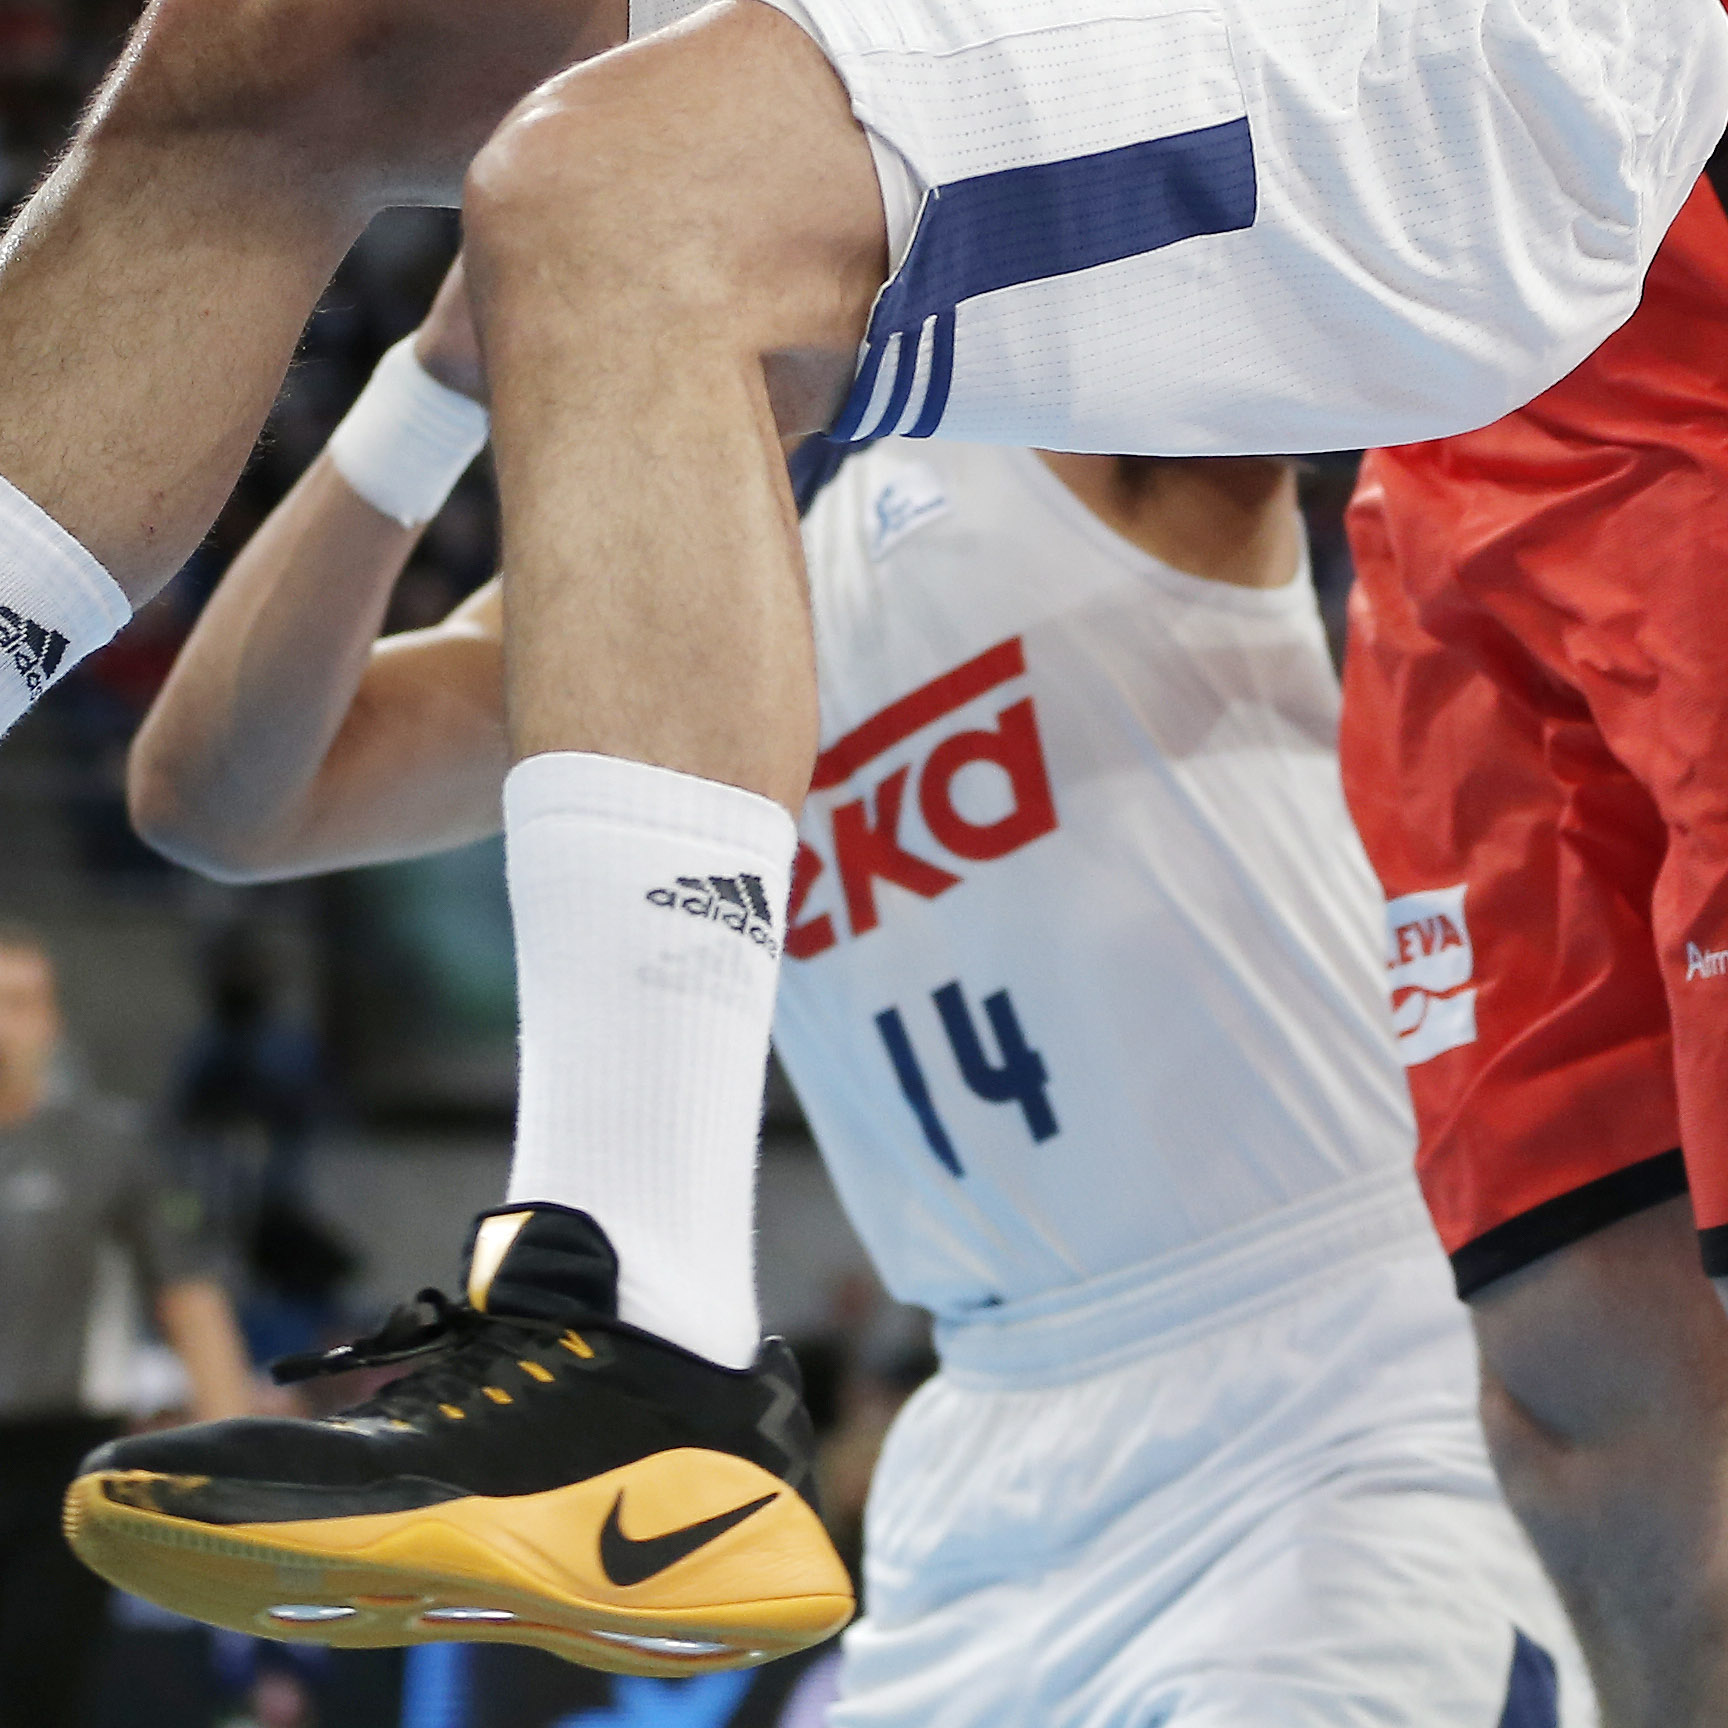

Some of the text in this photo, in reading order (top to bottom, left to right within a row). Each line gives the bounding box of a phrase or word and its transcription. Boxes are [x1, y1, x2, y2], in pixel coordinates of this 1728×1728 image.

[784, 634, 1059, 962] eka
[1387, 913, 1464, 970] EVA
[874, 978, 1060, 1180] 14
